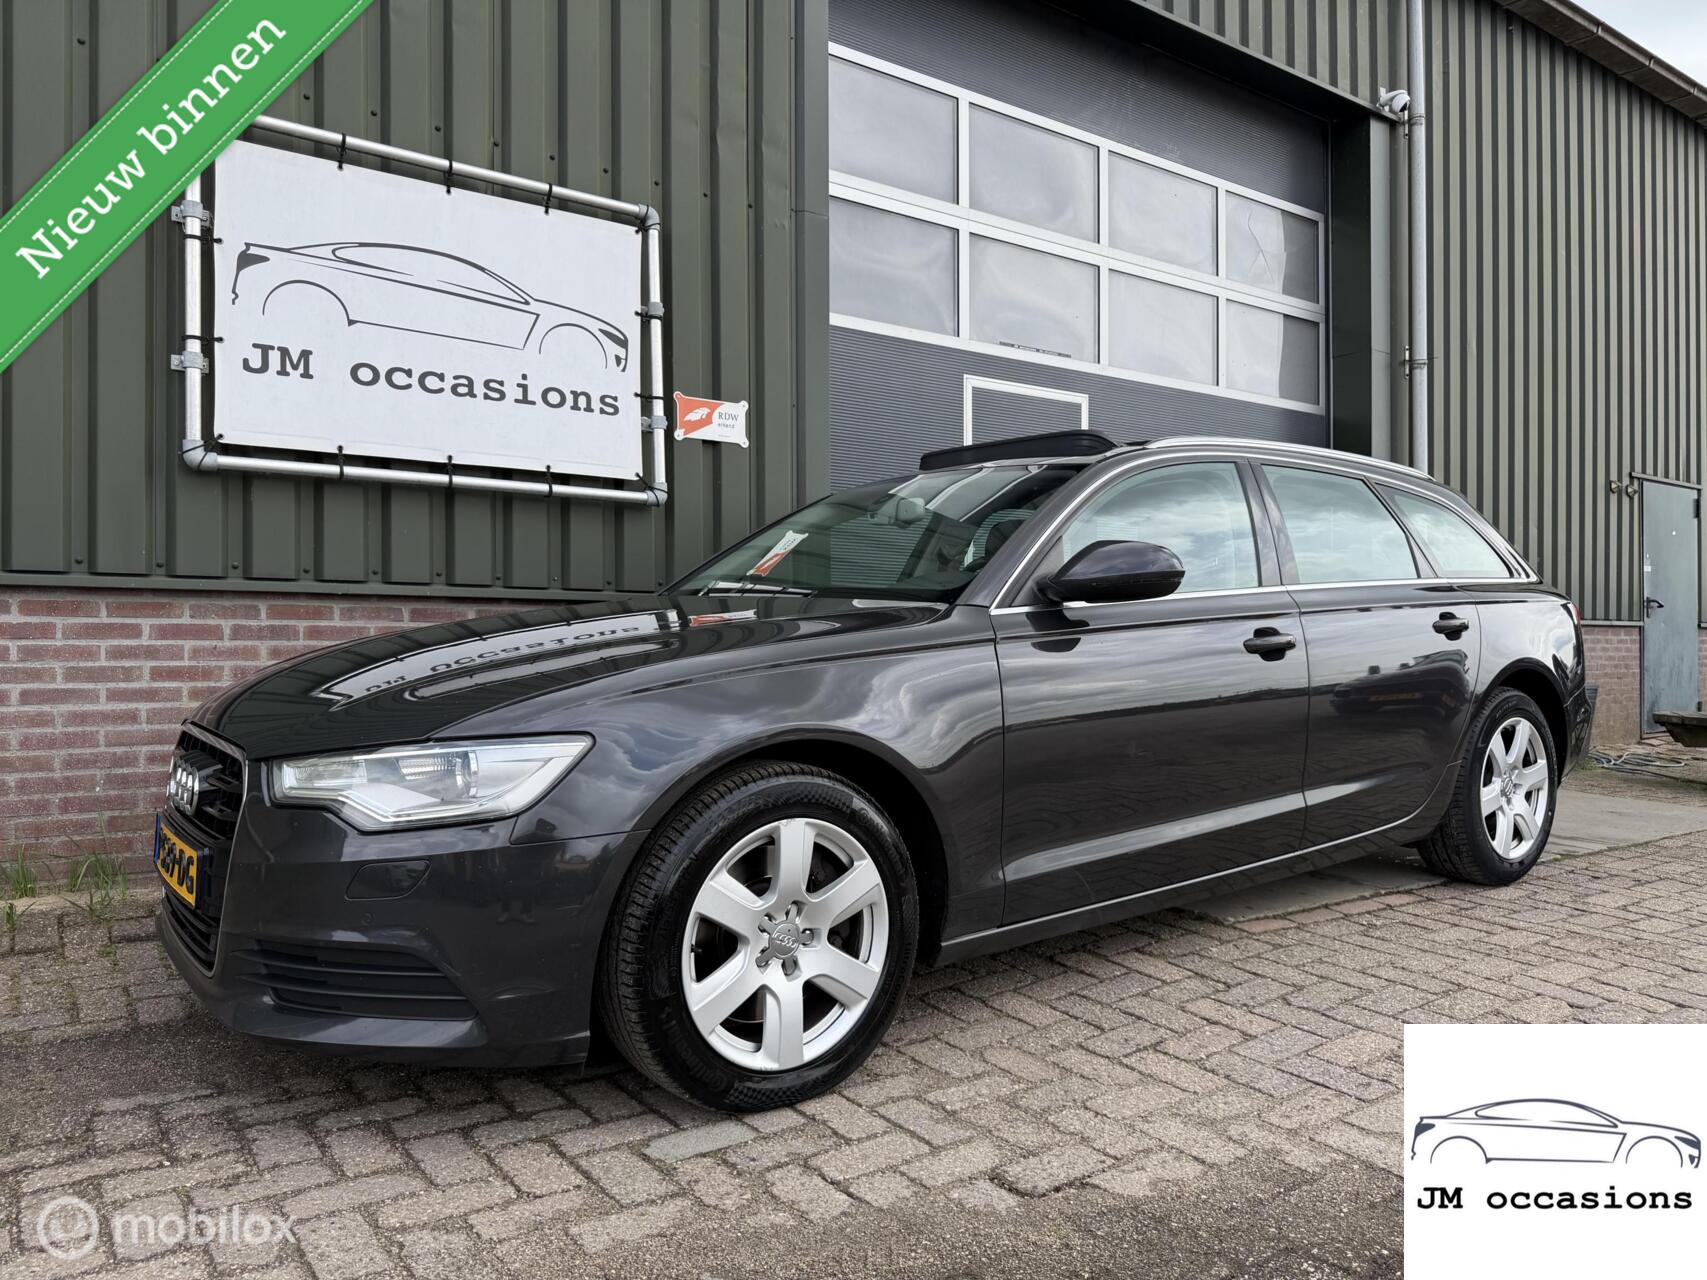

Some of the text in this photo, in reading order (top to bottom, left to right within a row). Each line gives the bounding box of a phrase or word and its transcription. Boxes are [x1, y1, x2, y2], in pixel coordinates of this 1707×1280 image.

[242, 342, 620, 417] JM occasions
[718, 411, 740, 421] RDW
